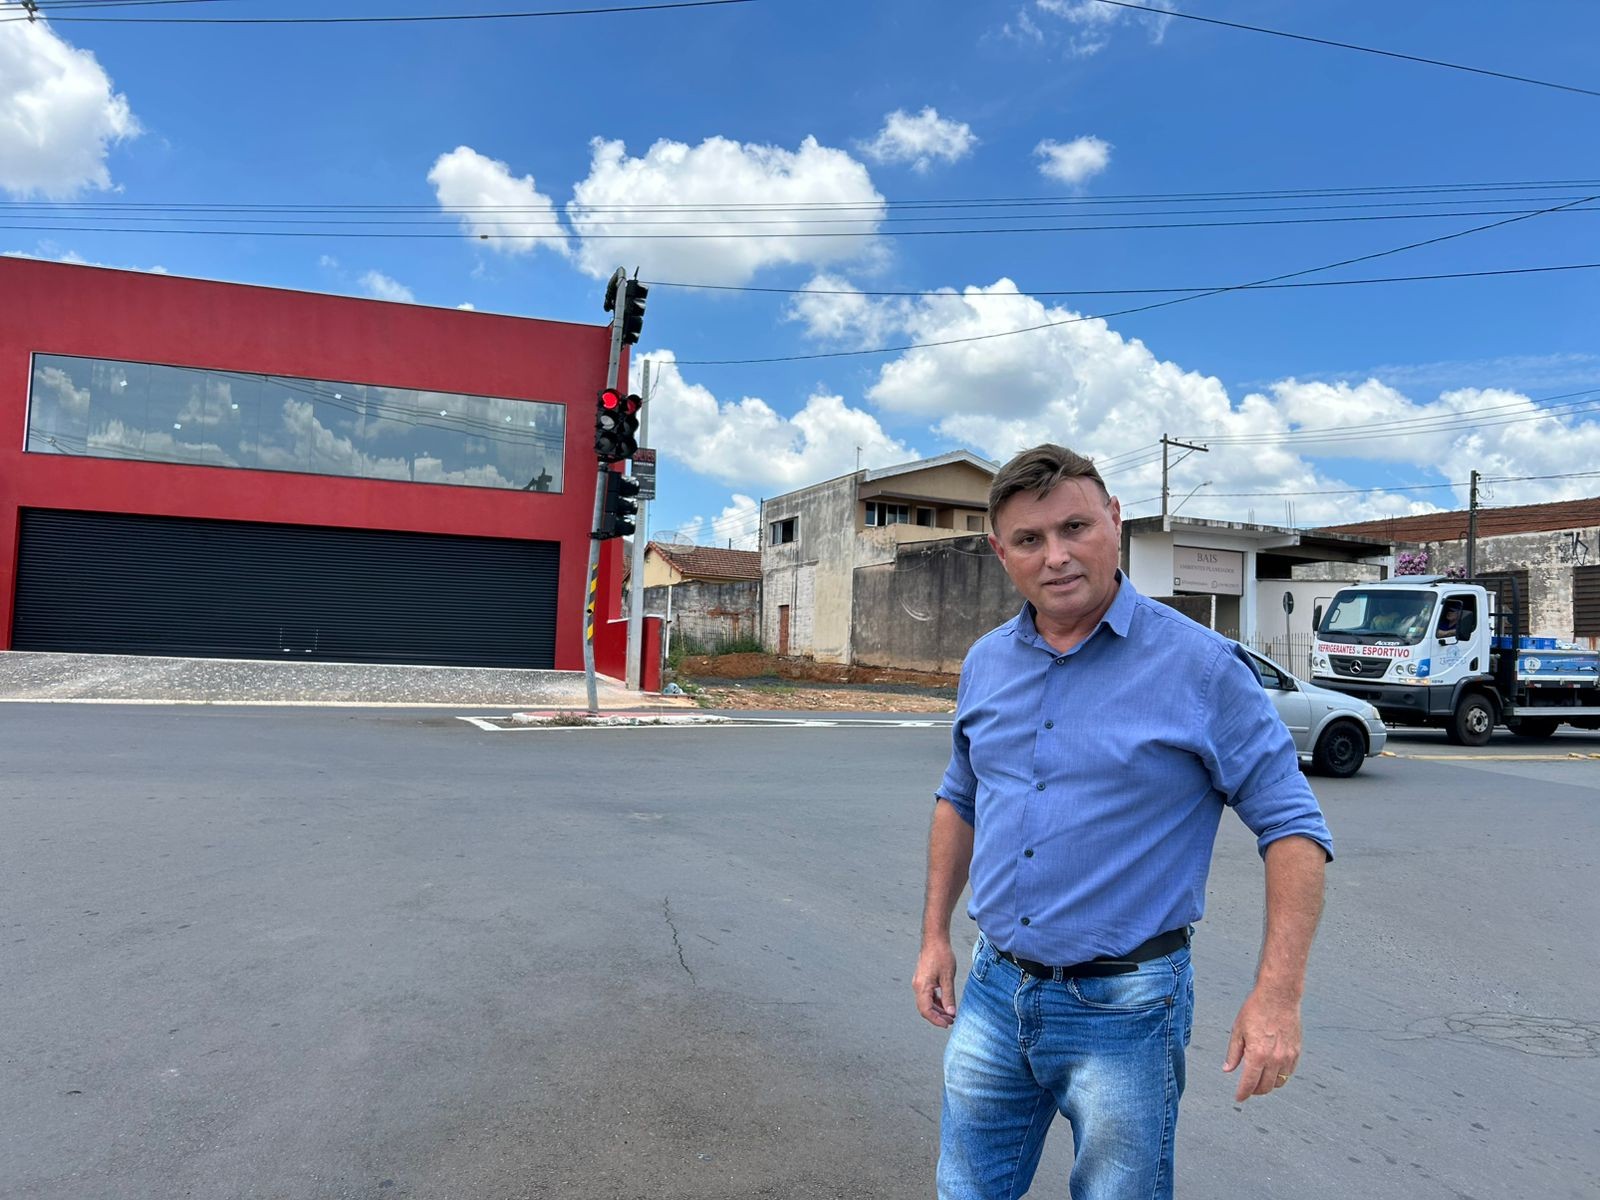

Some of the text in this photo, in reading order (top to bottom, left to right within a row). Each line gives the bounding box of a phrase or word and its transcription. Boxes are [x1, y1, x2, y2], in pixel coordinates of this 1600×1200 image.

[1197, 552, 1218, 563] BAIS
[1318, 643, 1356, 655] REFRIGERANTES
[1362, 646, 1410, 658] ESPORTIVO
